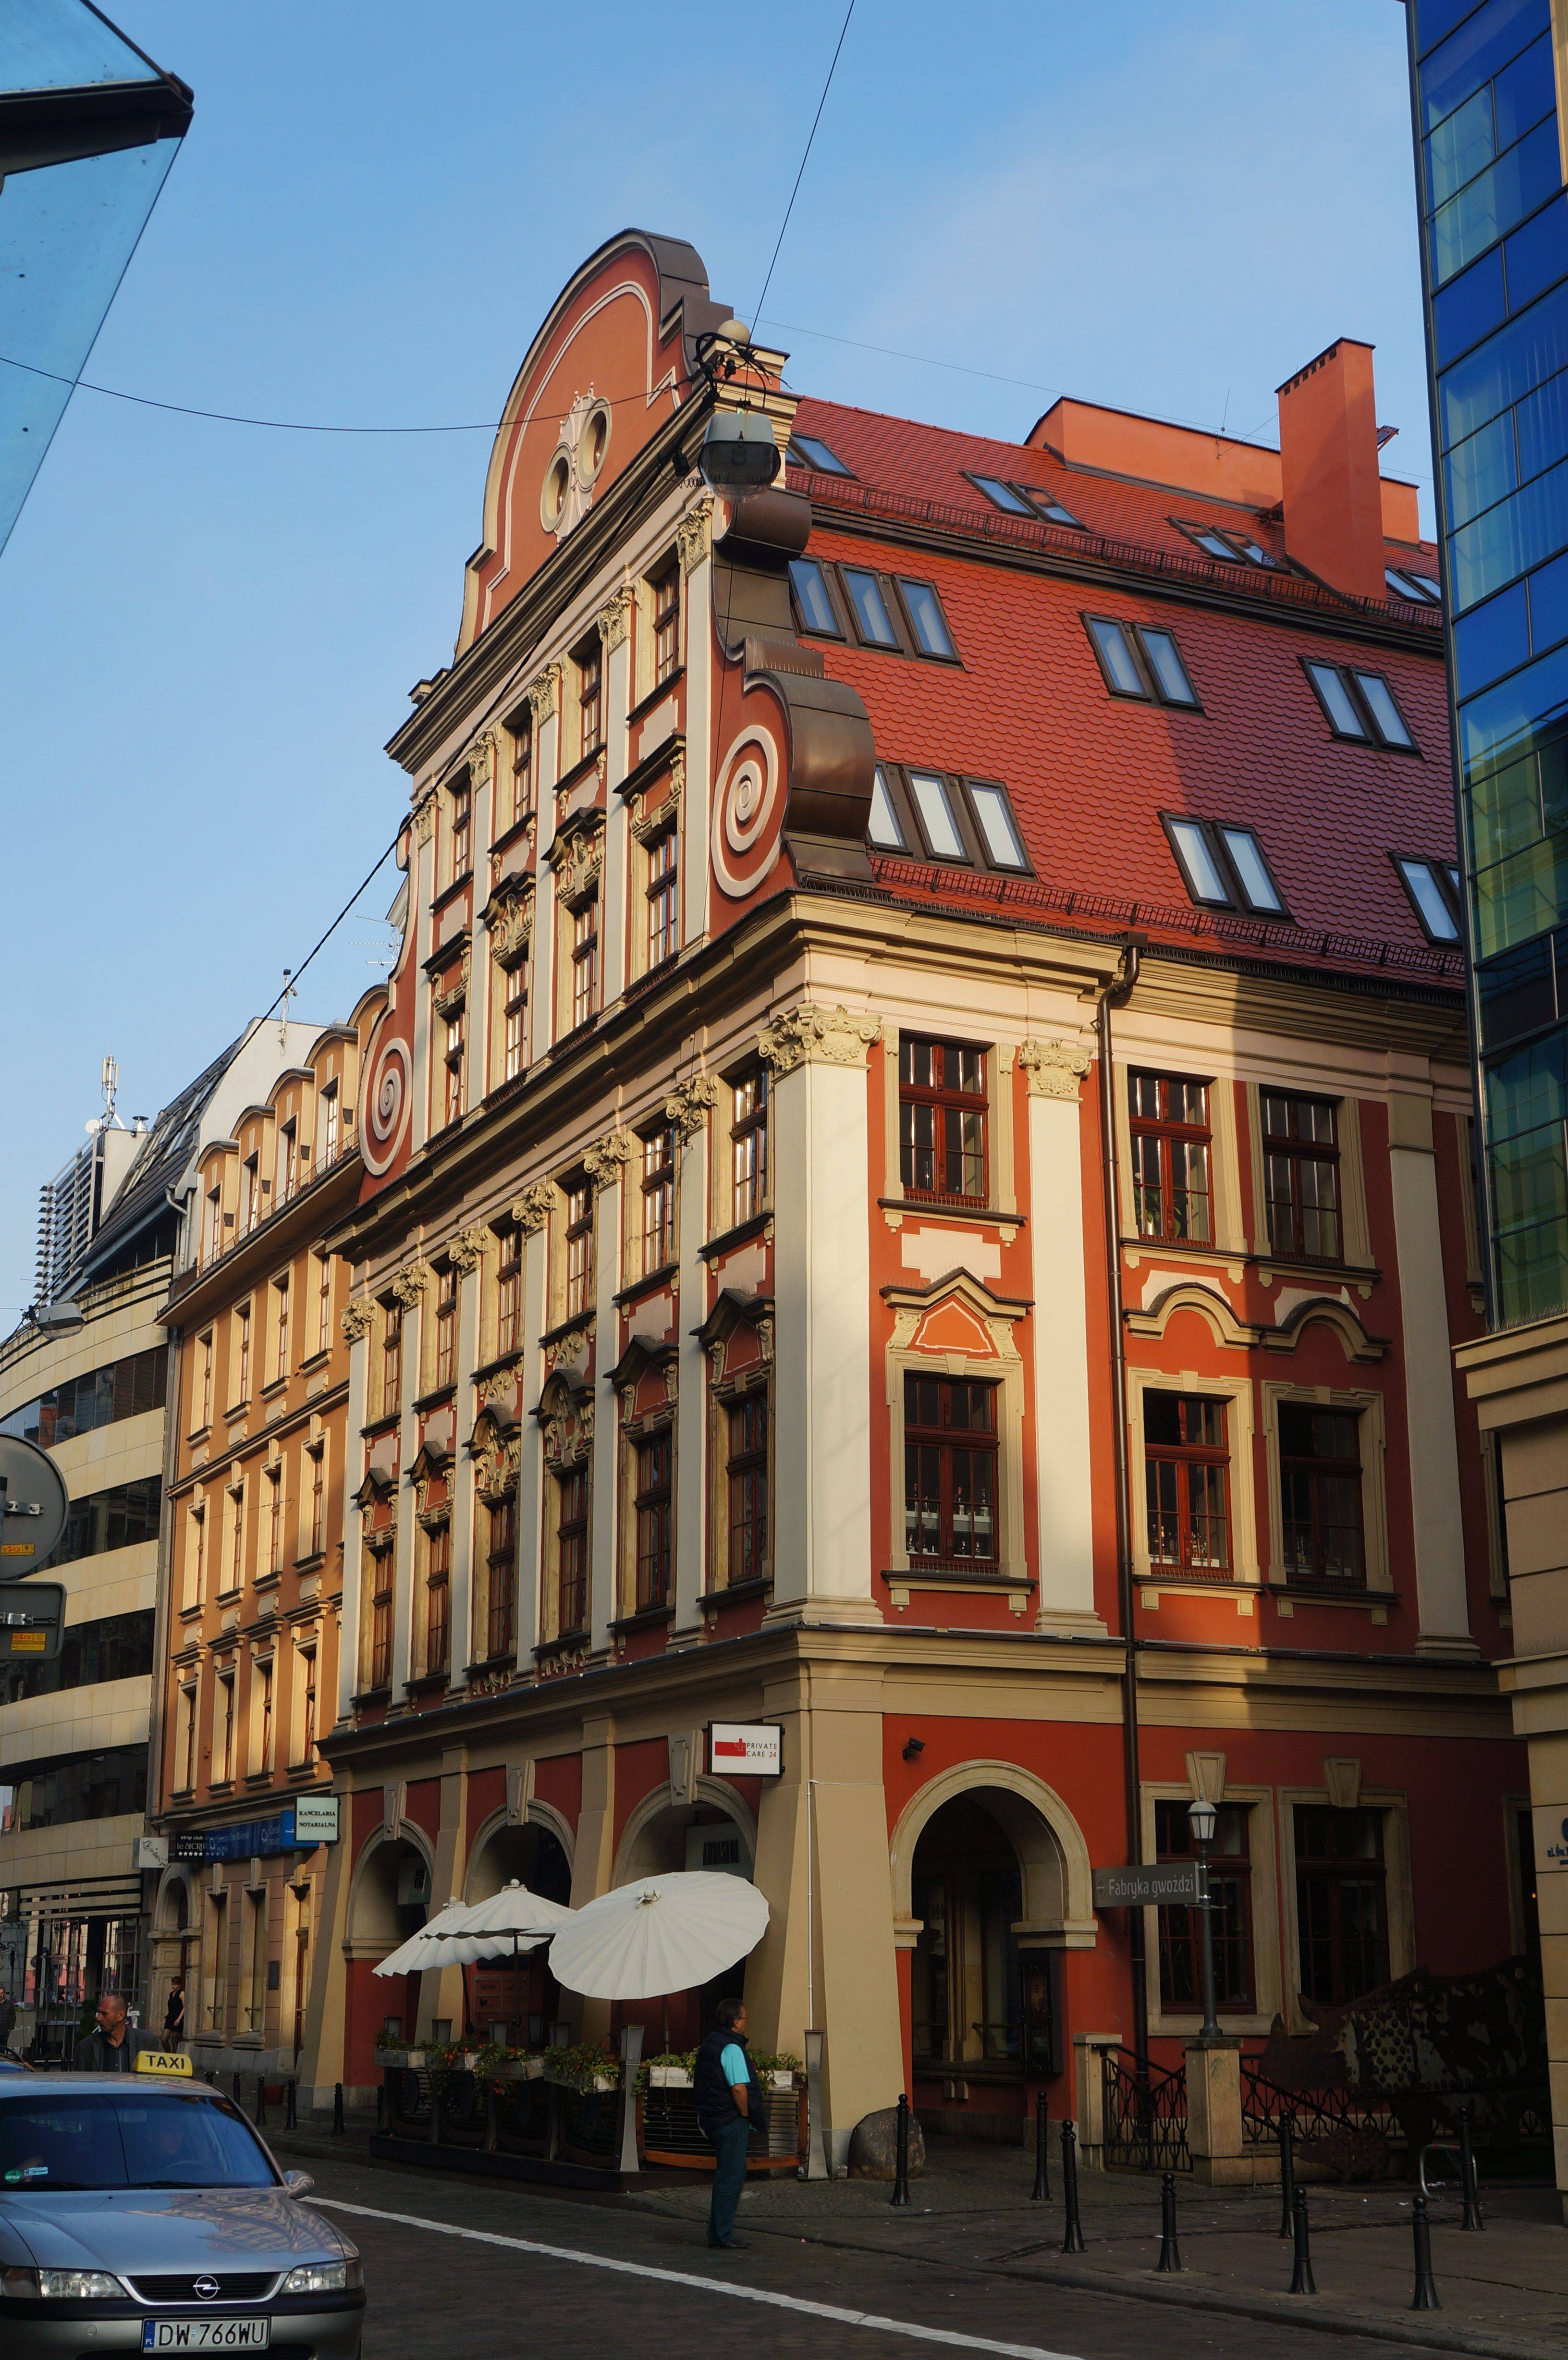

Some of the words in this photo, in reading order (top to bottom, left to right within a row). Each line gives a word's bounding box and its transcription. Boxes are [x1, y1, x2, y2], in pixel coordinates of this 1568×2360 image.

[1109, 1877, 1149, 1899] Fabryka
[1152, 1873, 1193, 1898] gwoździ
[145, 2055, 185, 2070] TAXI
[159, 2323, 191, 2346] DW
[198, 2322, 264, 2346] 766WU
